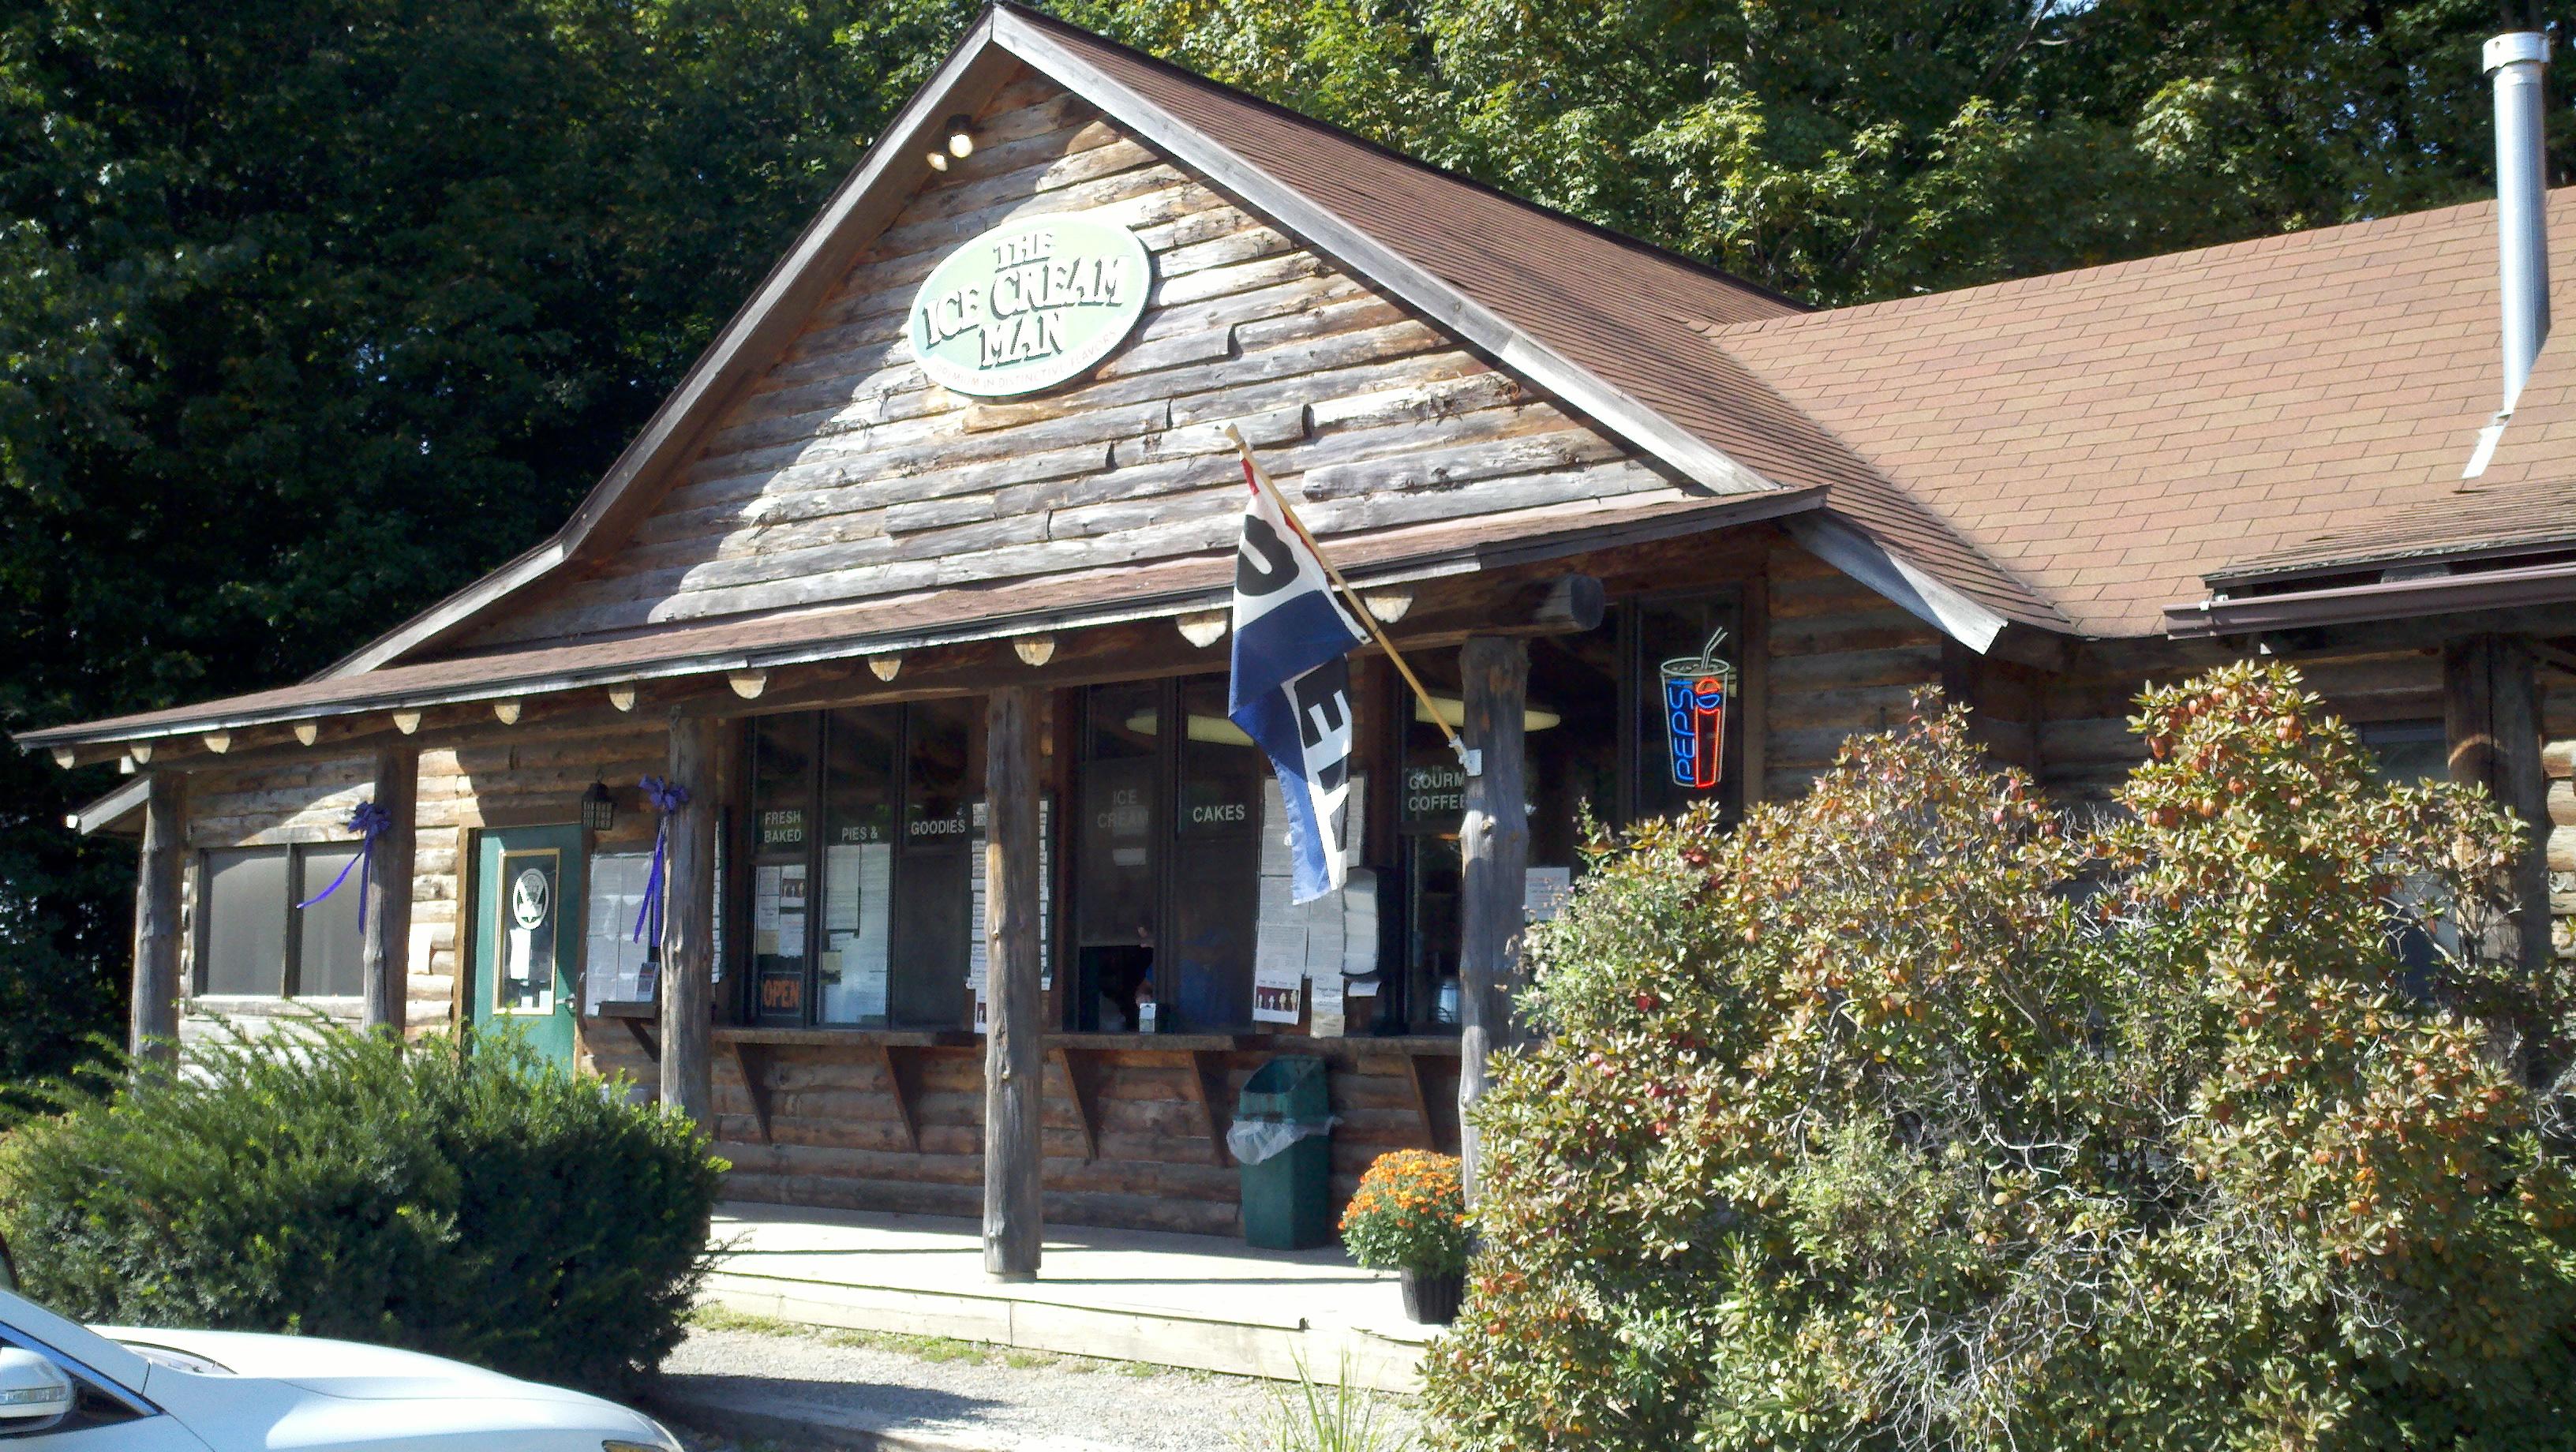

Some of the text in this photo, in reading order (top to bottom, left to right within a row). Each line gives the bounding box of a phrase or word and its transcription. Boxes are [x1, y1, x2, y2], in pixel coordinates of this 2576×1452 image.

[993, 226, 1056, 272] THE
[923, 254, 1130, 350] ICE CREAM
[979, 311, 1064, 370] MAN
[1668, 679, 1695, 781] PEPSI
[1409, 770, 1465, 790] GOURM
[1113, 789, 1137, 805] ICE
[764, 810, 801, 825] FRESH
[1193, 803, 1245, 823] CAKES
[763, 828, 802, 844] BAKED
[841, 825, 878, 841] PIES &
[910, 818, 966, 836] GOODIES
[762, 979, 799, 1009] OPEN
